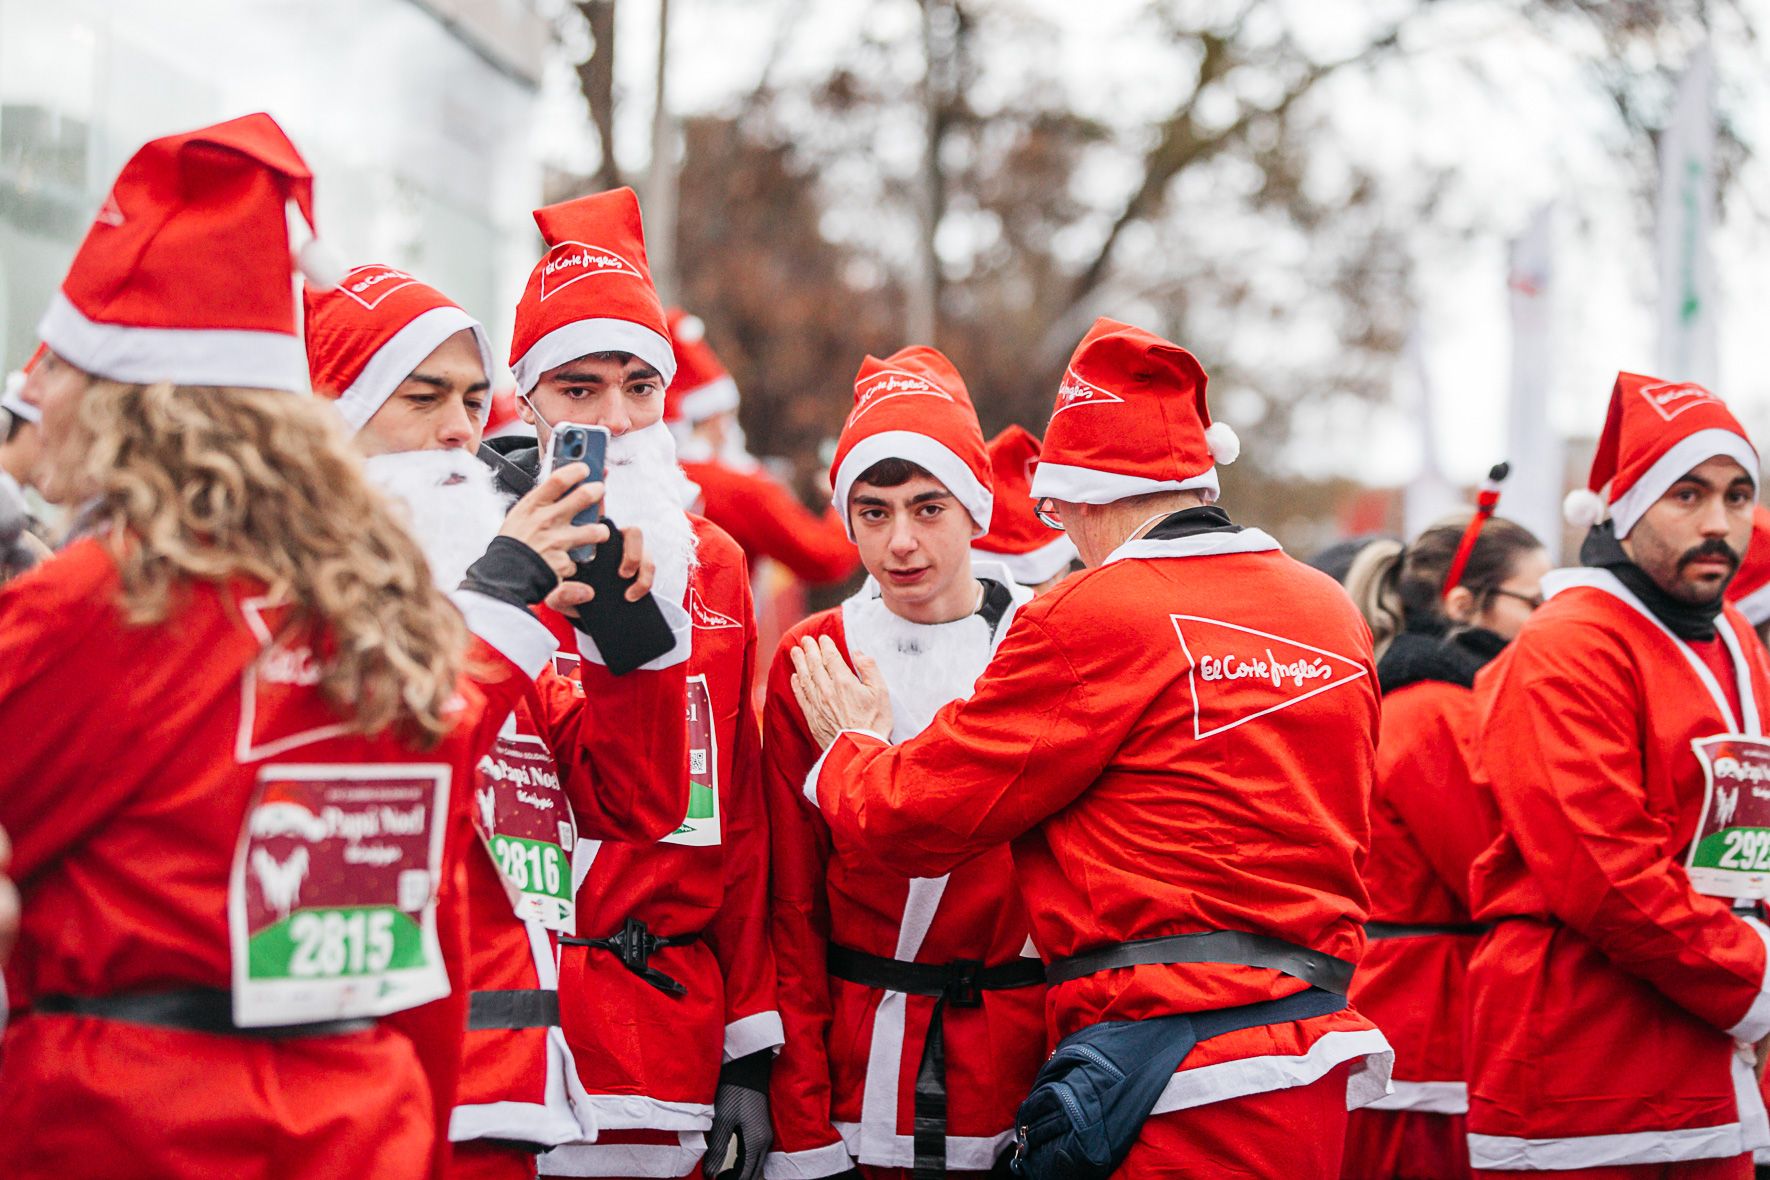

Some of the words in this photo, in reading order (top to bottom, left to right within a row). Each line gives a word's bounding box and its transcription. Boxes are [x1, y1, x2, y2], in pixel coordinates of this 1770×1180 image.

[1200, 655, 1222, 681] El
[1223, 654, 1270, 680] Corte
[1265, 648, 1332, 688] Inglés
[498, 758, 531, 788] Papá
[529, 766, 561, 791] Noel
[495, 838, 560, 895] 2816
[1719, 831, 1770, 870] 292
[288, 910, 395, 977] 2815
